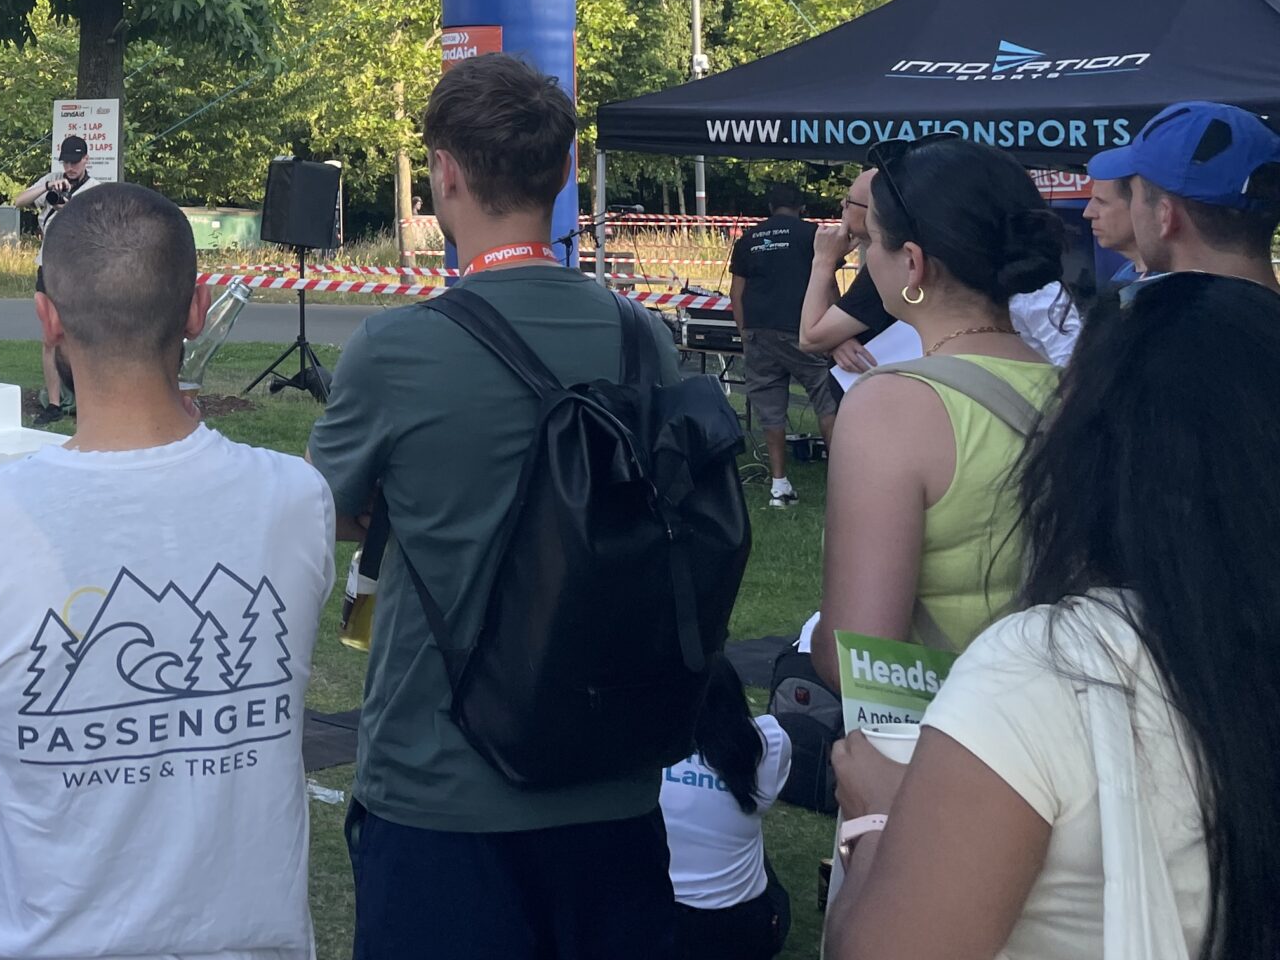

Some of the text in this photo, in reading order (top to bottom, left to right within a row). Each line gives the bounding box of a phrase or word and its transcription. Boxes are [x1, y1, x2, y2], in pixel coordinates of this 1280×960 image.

[955, 72, 1061, 81] SPORTS
[89, 122, 103, 130] LAP
[88, 133, 106, 141] LAPS
[89, 143, 94, 151] 3
[95, 143, 113, 151] LAPS
[484, 246, 534, 265] LandAid
[850, 648, 945, 694] Heads
[17, 693, 292, 752] PASSENGER
[858, 706, 867, 722] A
[871, 712, 902, 724] note
[62, 750, 258, 789] WAVES & TREES
